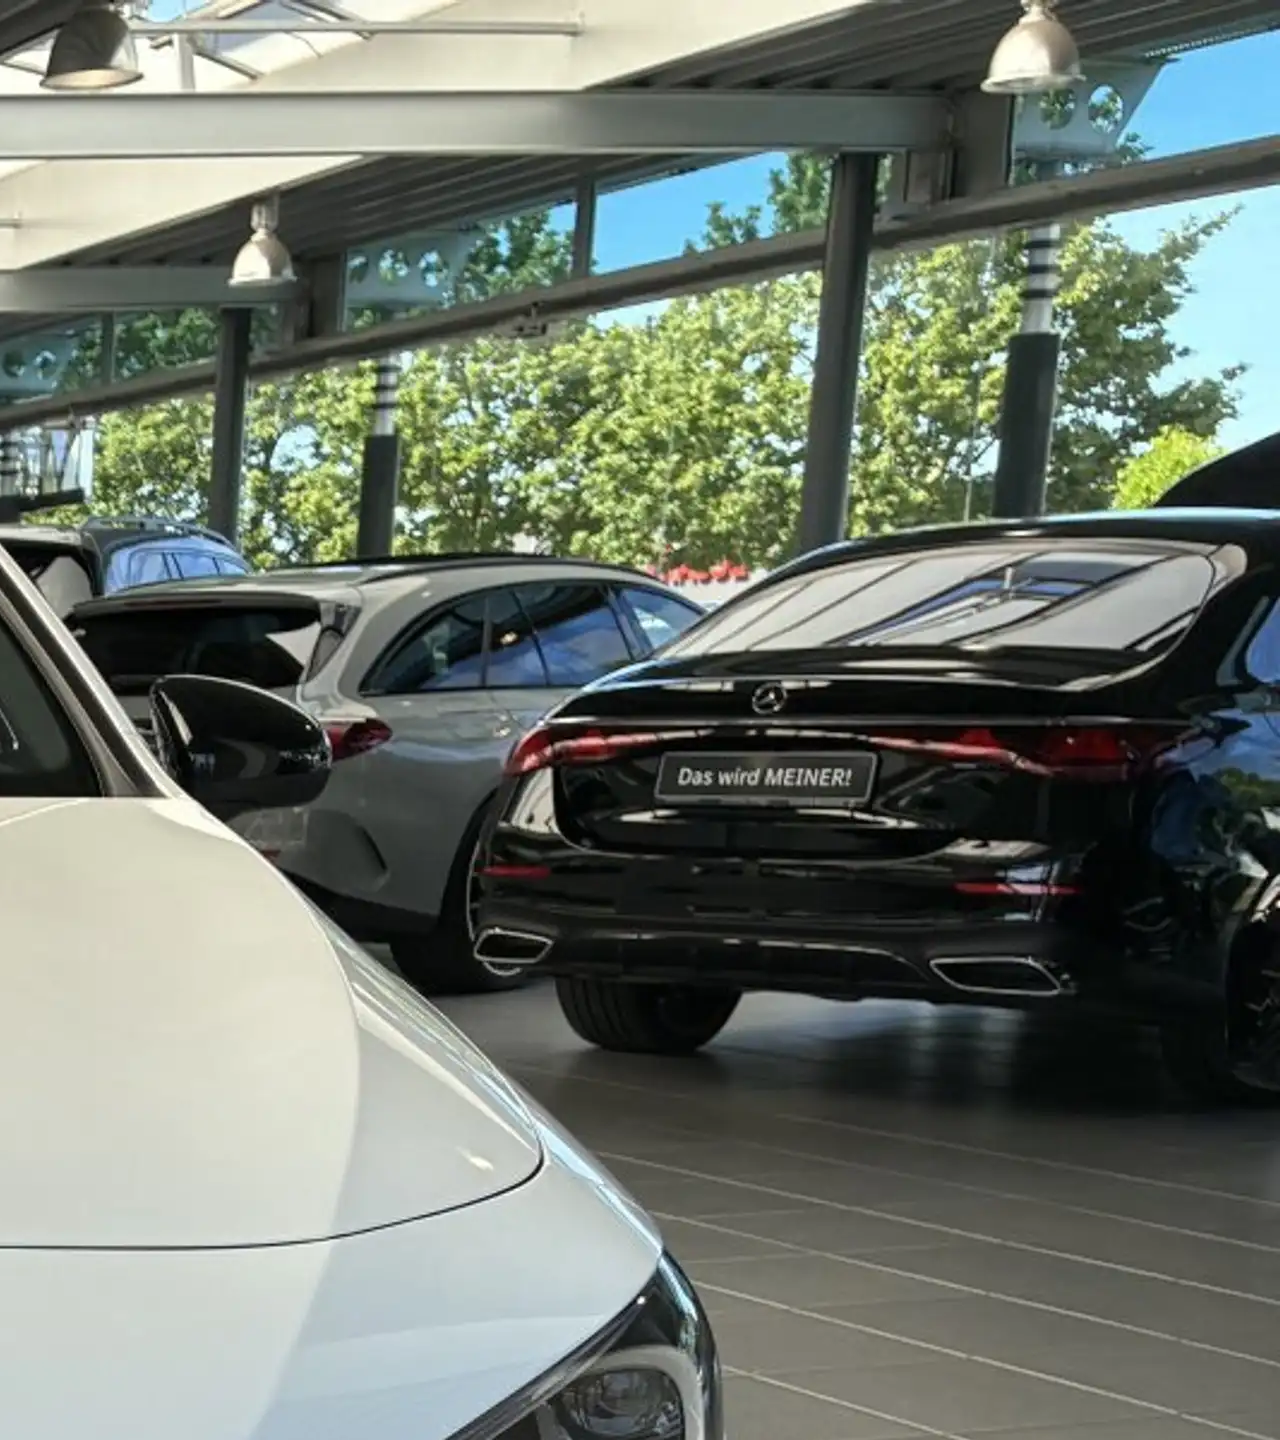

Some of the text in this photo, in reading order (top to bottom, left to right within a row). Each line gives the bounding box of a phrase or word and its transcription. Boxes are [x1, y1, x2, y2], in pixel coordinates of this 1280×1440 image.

[677, 767, 853, 787] Das wird MEINER!
